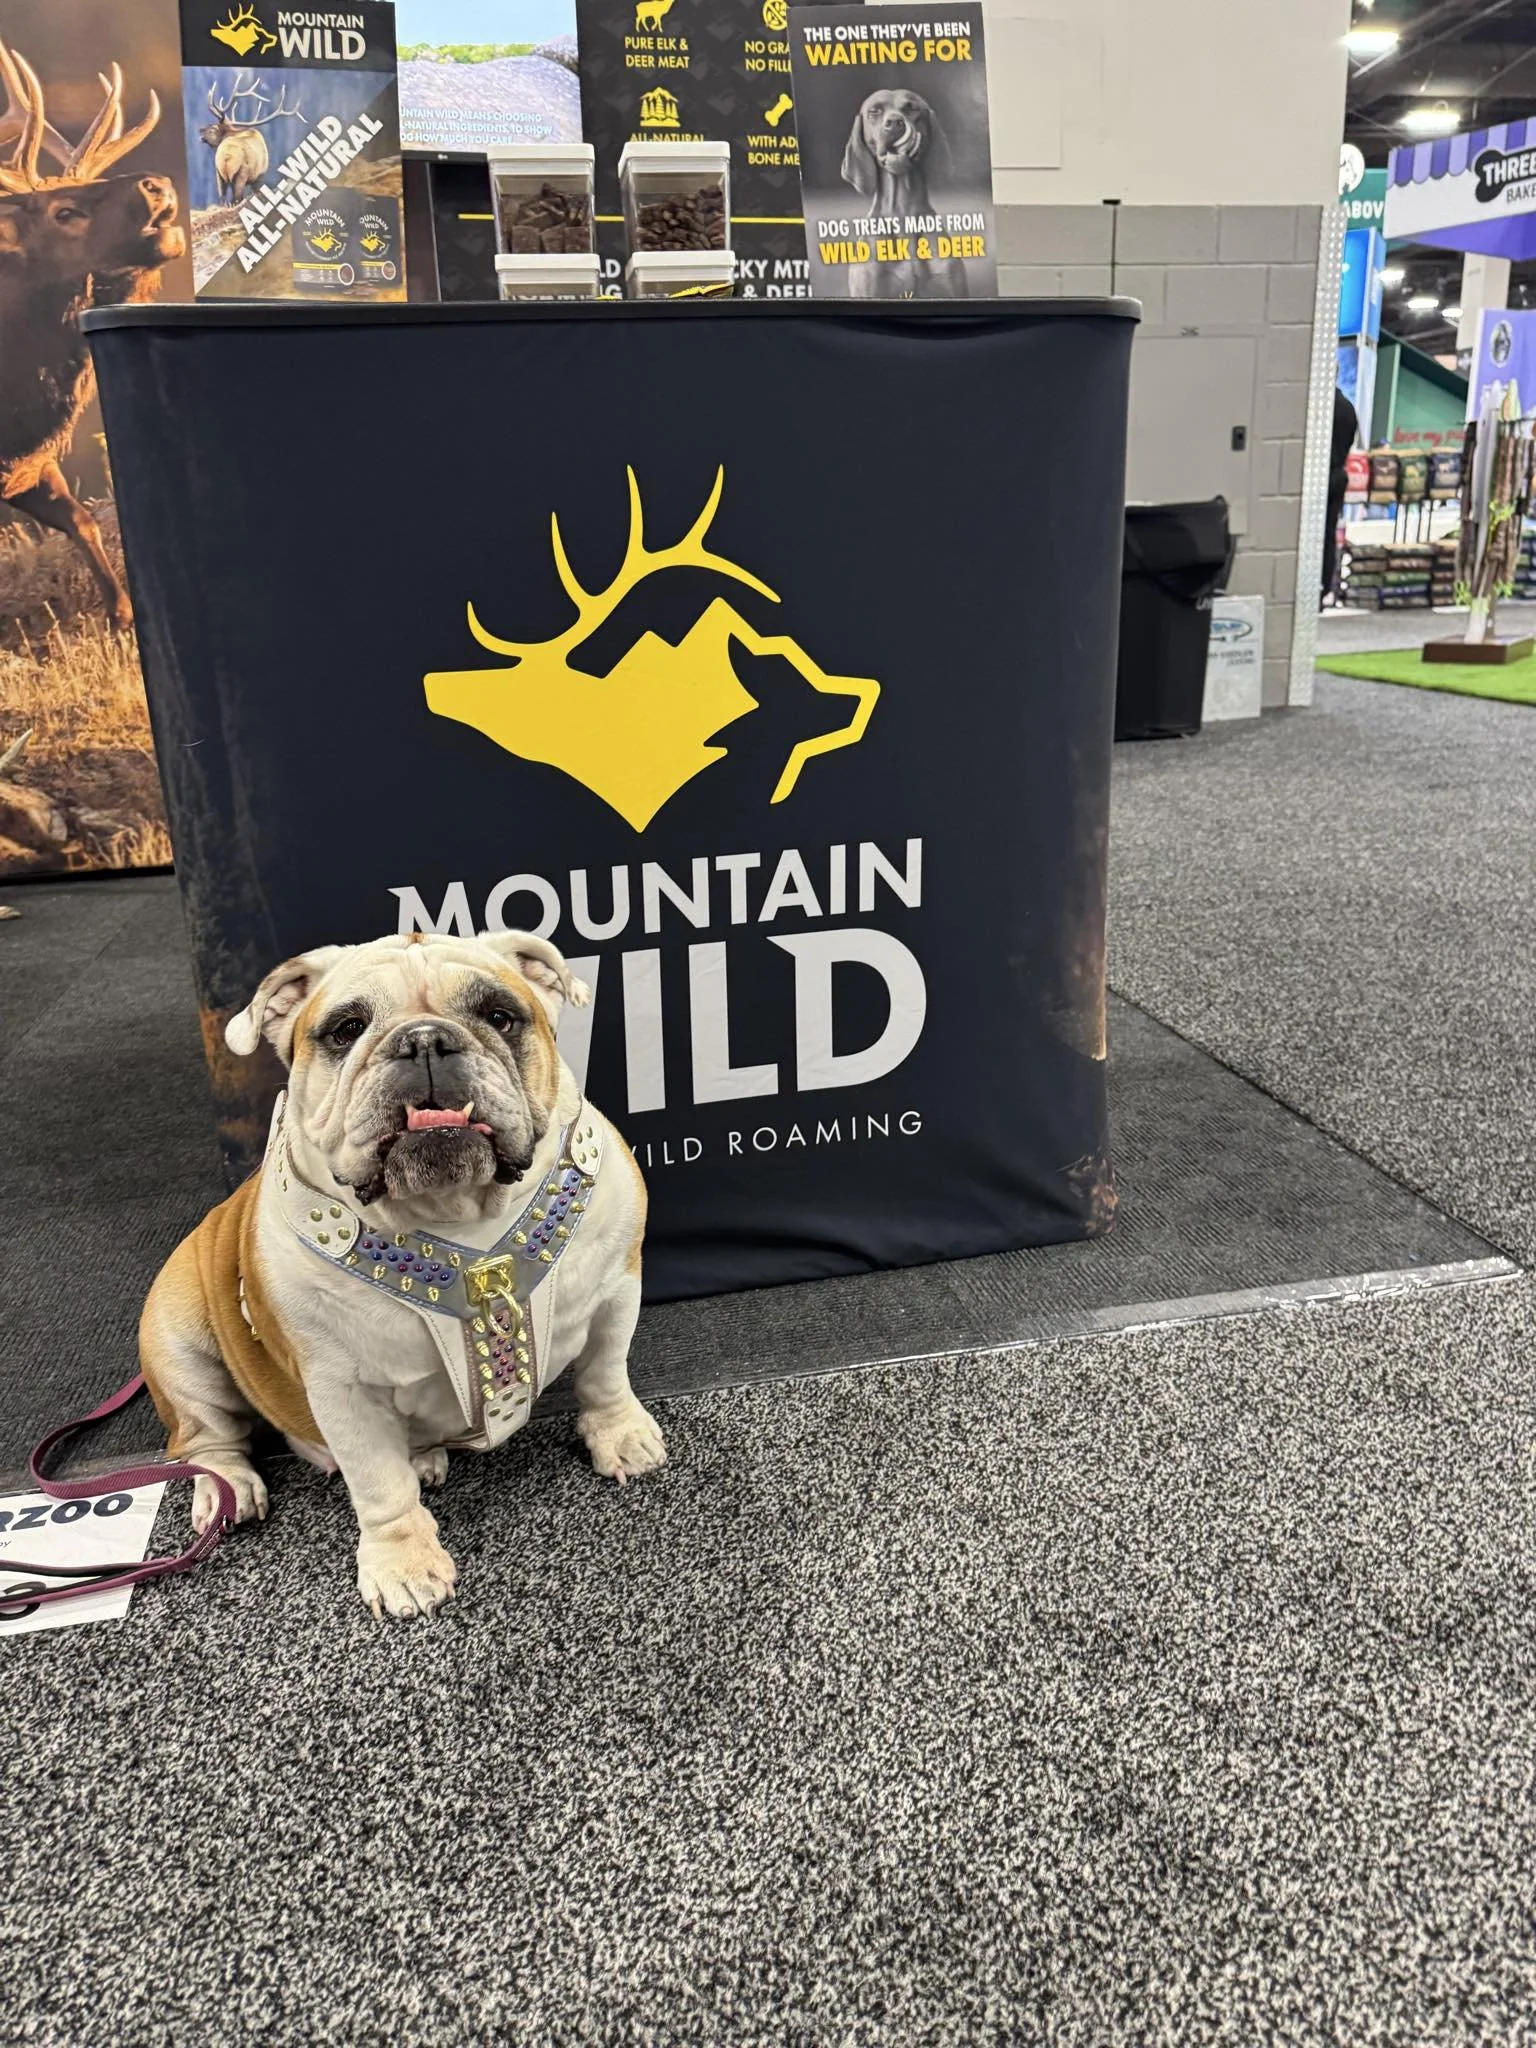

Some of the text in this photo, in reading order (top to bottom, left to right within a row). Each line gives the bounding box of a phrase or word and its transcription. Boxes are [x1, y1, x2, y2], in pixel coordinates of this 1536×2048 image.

[277, 11, 364, 29] MOUNTAIN
[803, 21, 971, 42] THE ONE THEY'VE BEEN
[278, 27, 366, 60] WILD
[624, 36, 688, 51] PURE ELK &
[745, 40, 766, 54] NO
[804, 39, 973, 67] WAITING FOR
[625, 54, 690, 69] DEER MEAT
[745, 58, 792, 73] NO FILL
[747, 135, 798, 149] WITH AD
[748, 152, 800, 166] BONE ME
[239, 116, 342, 234] ALL-WILD
[236, 113, 384, 274] ALL-NATURAL
[1507, 182, 1536, 205] BAKE
[304, 208, 346, 228] MOUNTAIN
[1343, 199, 1384, 219] ABOV
[316, 218, 335, 226] WILD
[360, 213, 389, 231] OUNTAIN
[364, 222, 380, 230] WILD
[818, 212, 985, 238] DOG TREATS MADE FROM
[819, 235, 986, 265] WILD ELK & DEER
[386, 838, 922, 941] MOUNTAIN
[629, 1110, 922, 1167] ILD ROAMING
